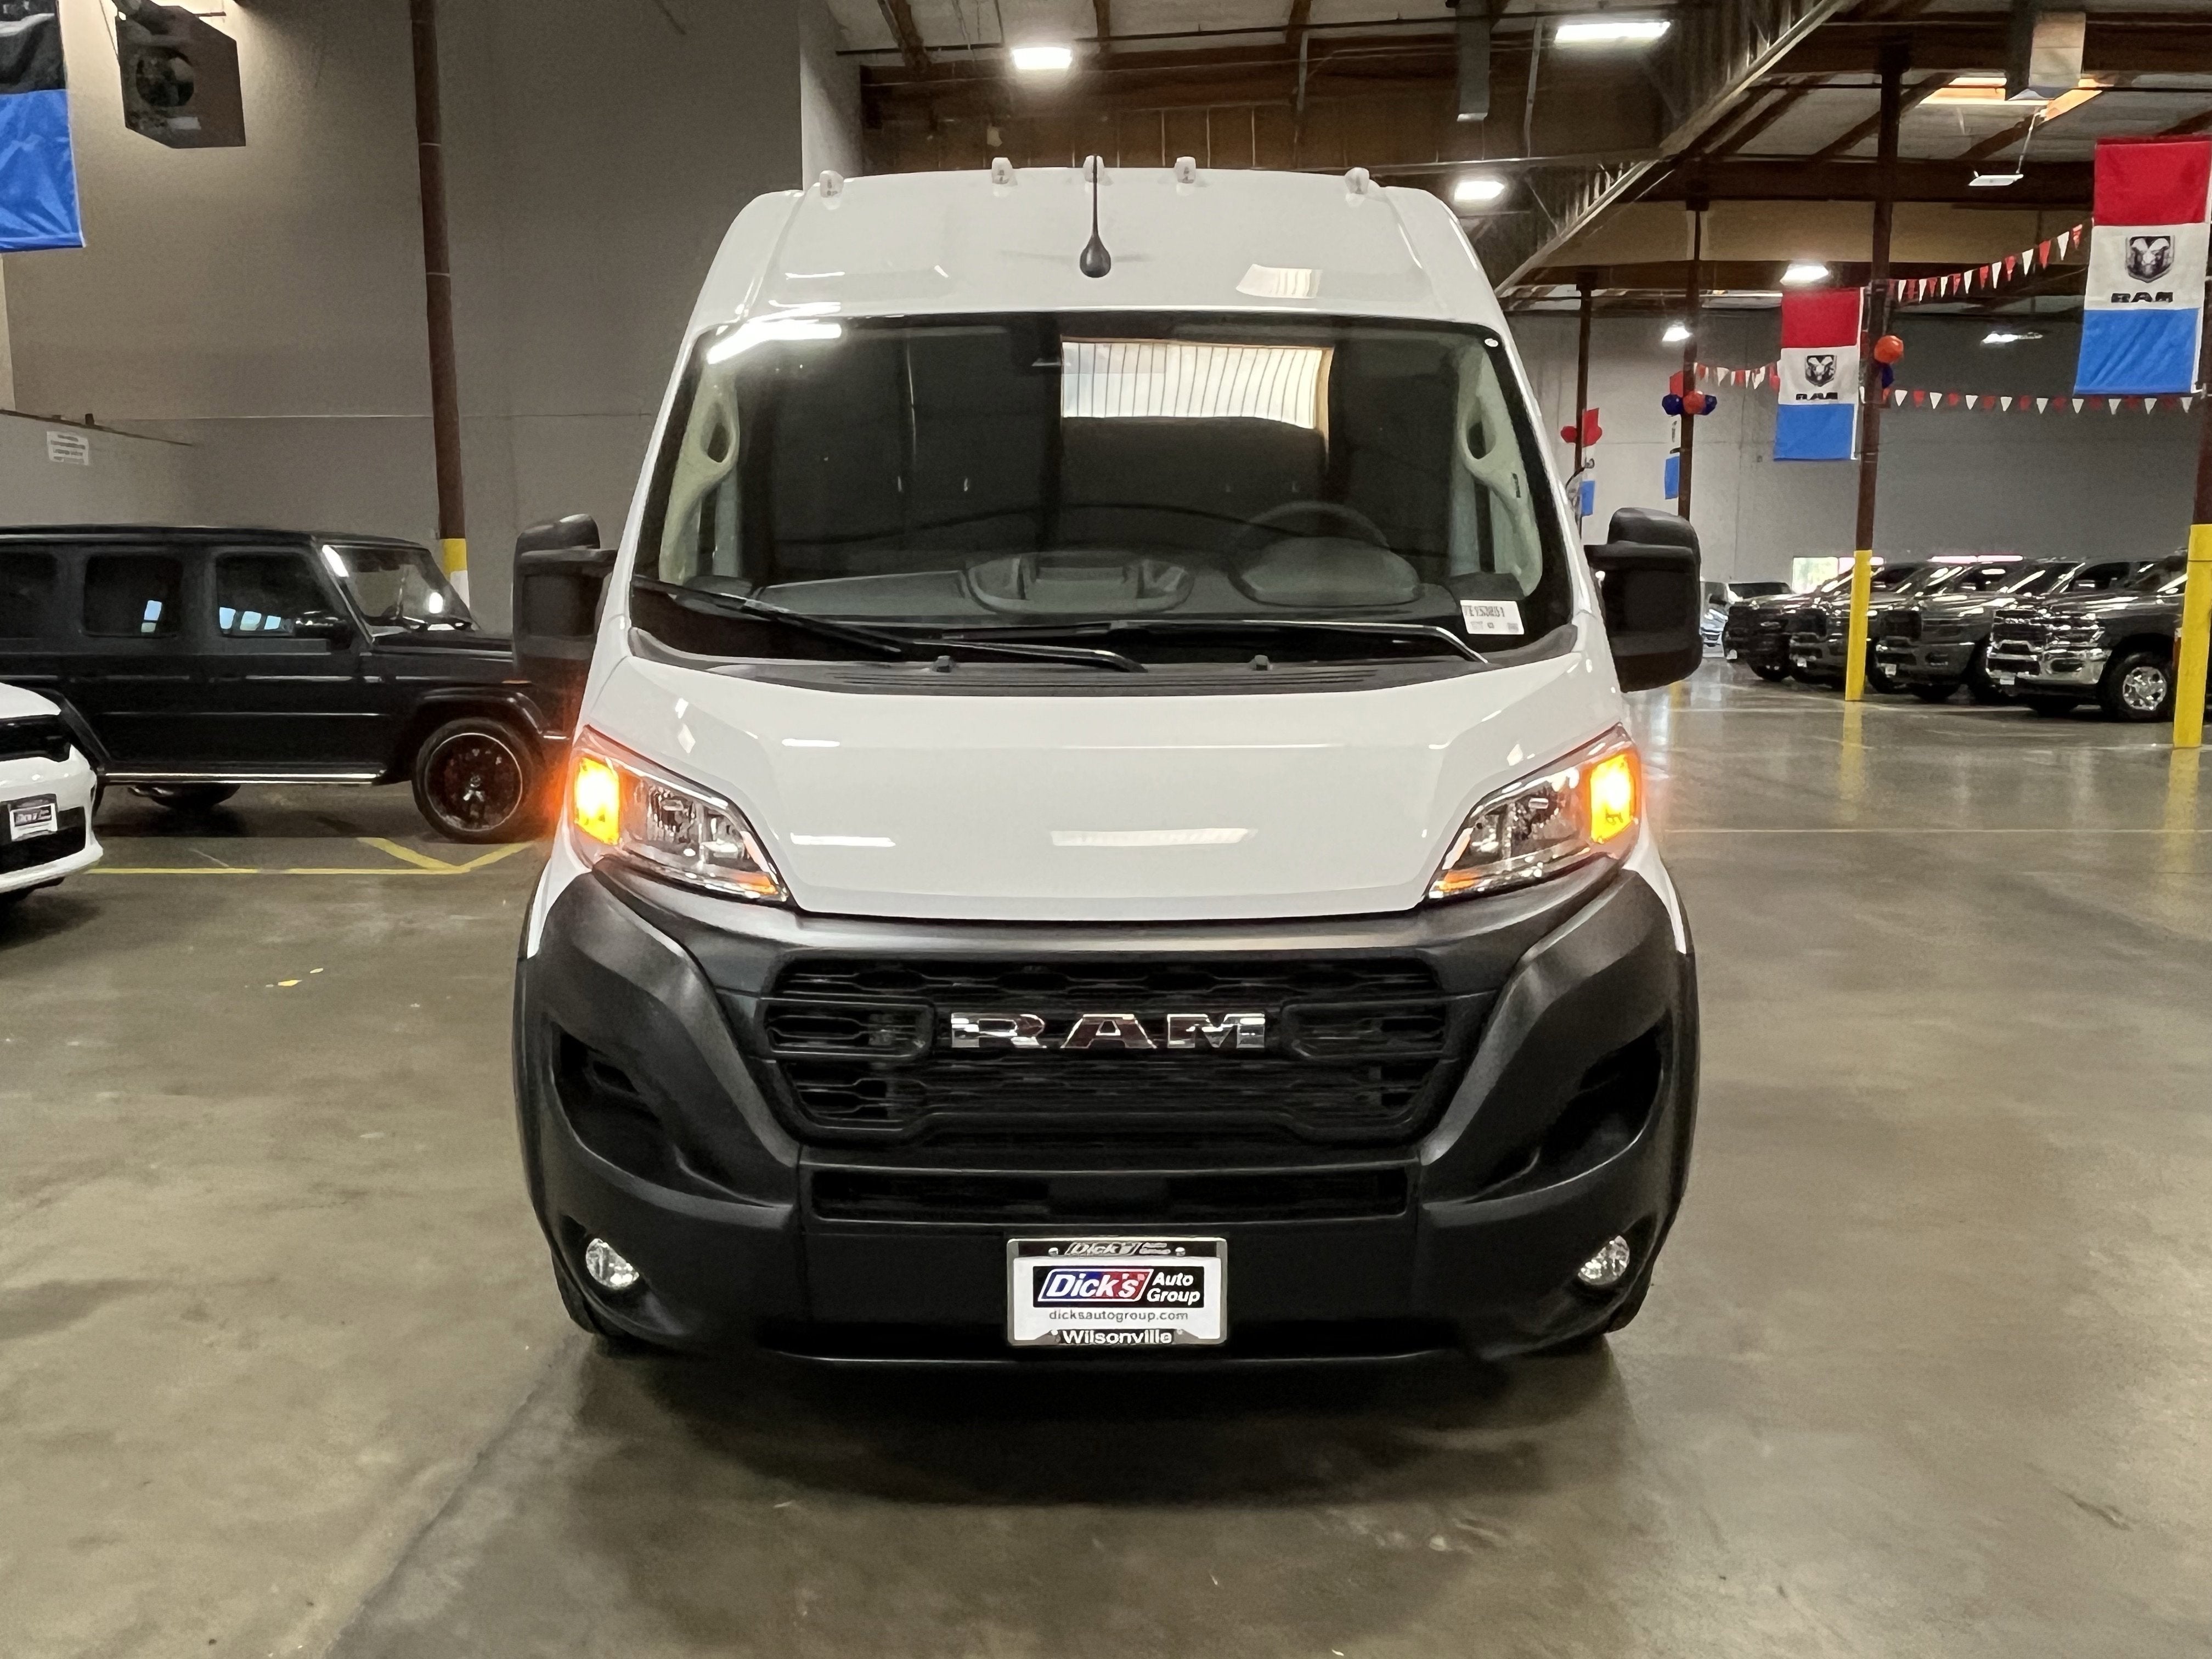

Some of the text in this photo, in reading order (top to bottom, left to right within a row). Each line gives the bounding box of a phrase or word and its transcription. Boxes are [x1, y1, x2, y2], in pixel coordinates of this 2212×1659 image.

[951, 1013, 1265, 1048] RAM
[1046, 1273, 1139, 1298] Dick's
[1153, 1272, 1194, 1286] Auto
[1147, 1288, 1200, 1305] Group
[1049, 1309, 1188, 1322] dicksautogroup.com
[1063, 1330, 1172, 1344] Wilsonville
